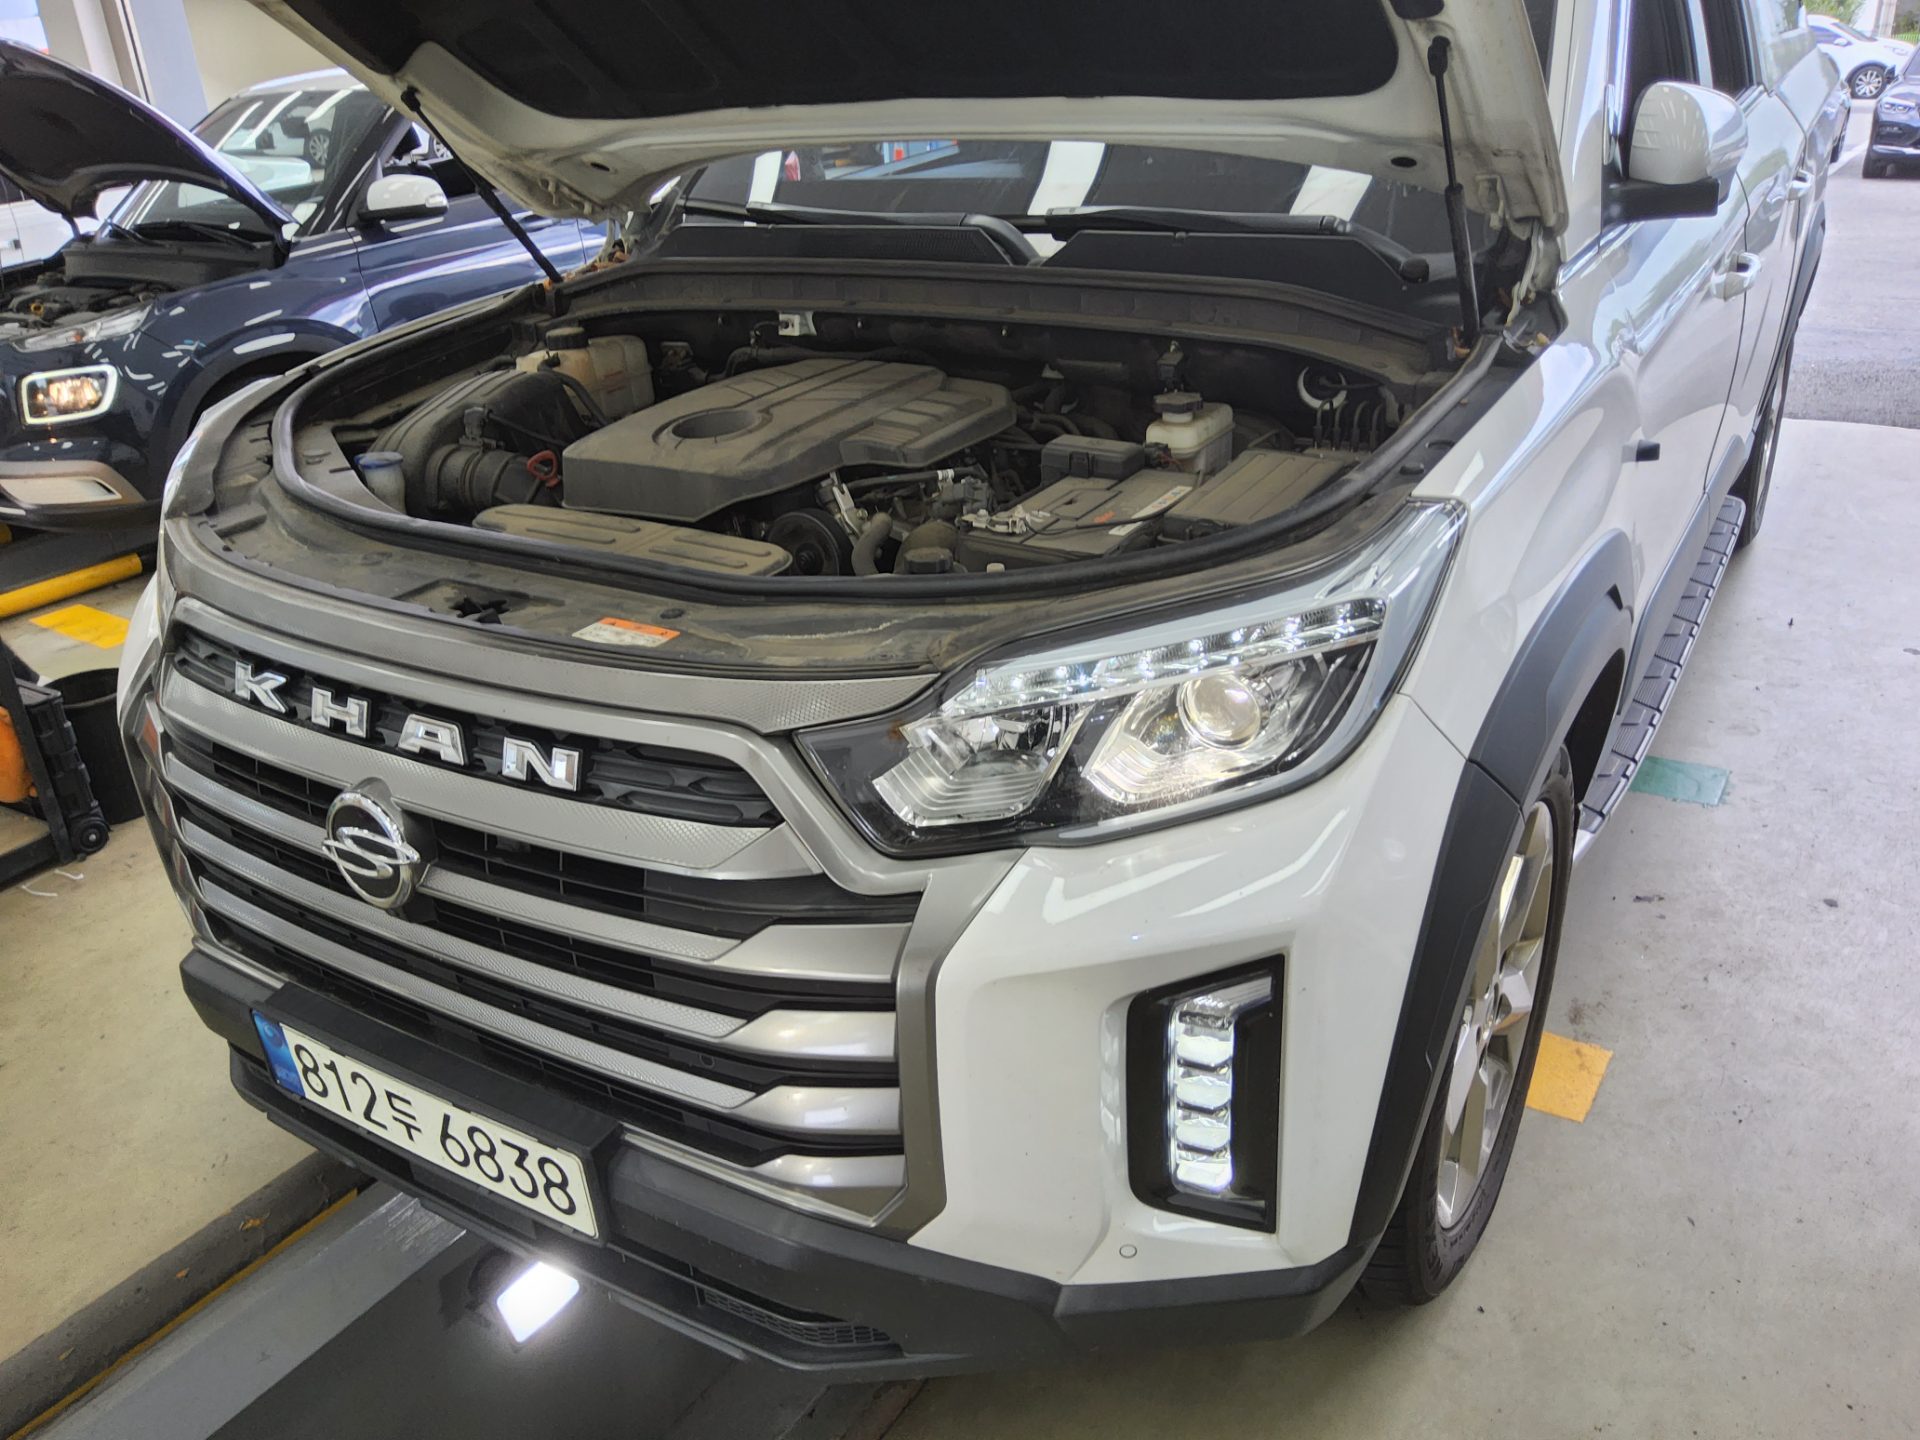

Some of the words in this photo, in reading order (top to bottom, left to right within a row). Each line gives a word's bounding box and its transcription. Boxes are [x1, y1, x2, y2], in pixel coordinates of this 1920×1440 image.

[234, 659, 579, 792] KHAN
[294, 1043, 422, 1142] 812두
[439, 1113, 577, 1216] 6838
